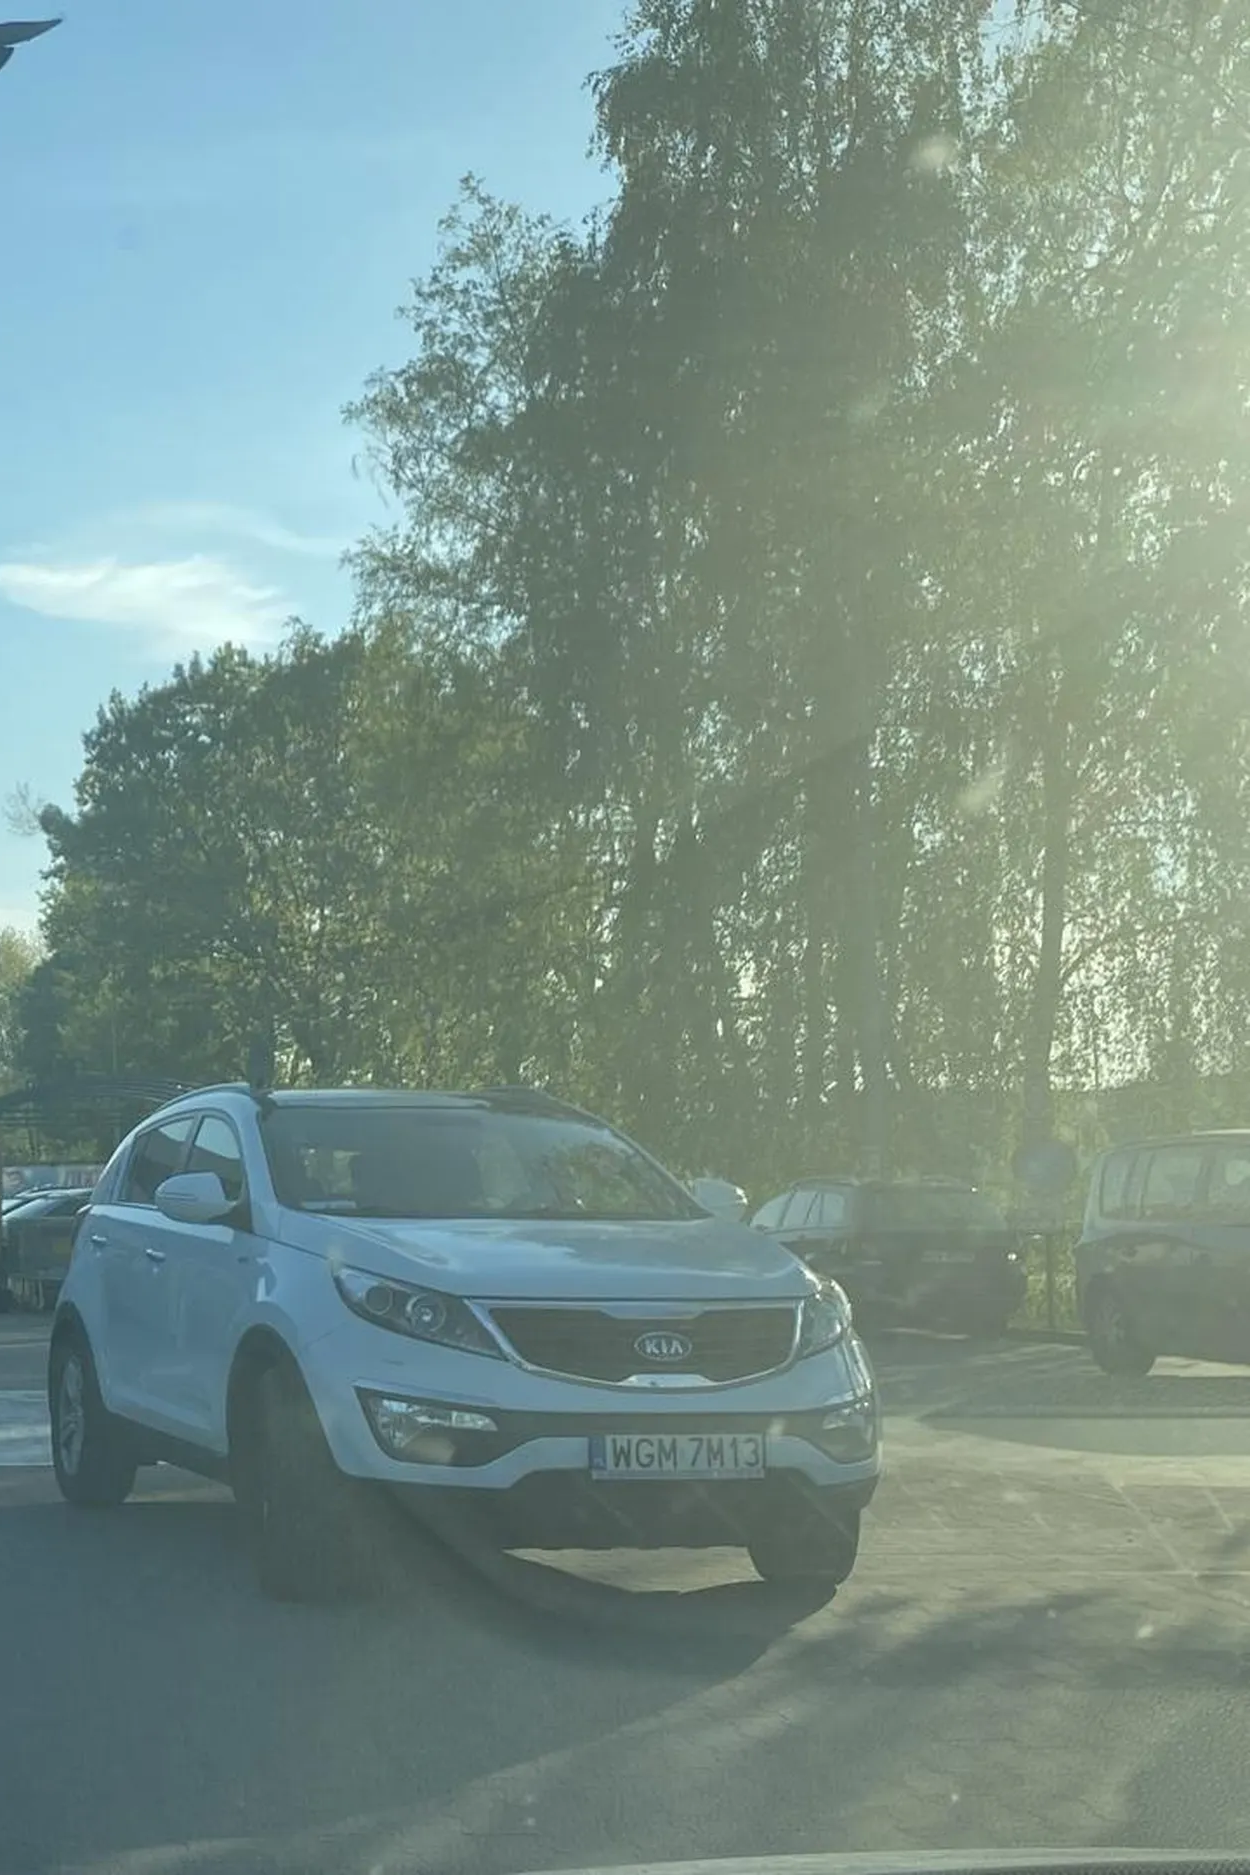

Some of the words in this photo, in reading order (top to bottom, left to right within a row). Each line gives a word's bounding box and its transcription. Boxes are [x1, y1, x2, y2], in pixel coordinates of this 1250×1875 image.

[644, 1338, 684, 1355] KIA
[611, 1437, 678, 1469] WGM
[687, 1437, 761, 1468] 7M13
